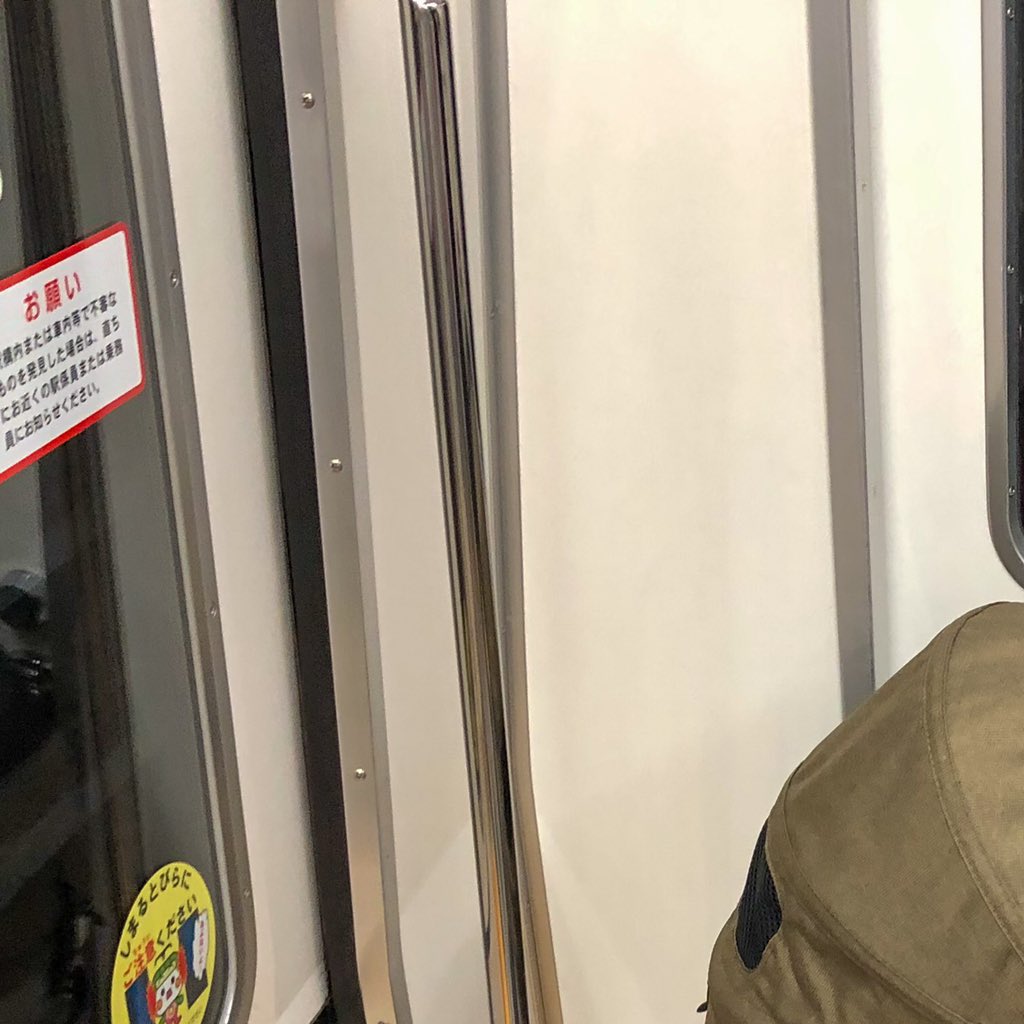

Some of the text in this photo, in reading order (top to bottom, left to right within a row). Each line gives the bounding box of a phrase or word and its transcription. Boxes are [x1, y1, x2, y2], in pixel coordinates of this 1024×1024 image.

[23, 272, 81, 322] お願い
[120, 866, 192, 958] しまるとびらに
